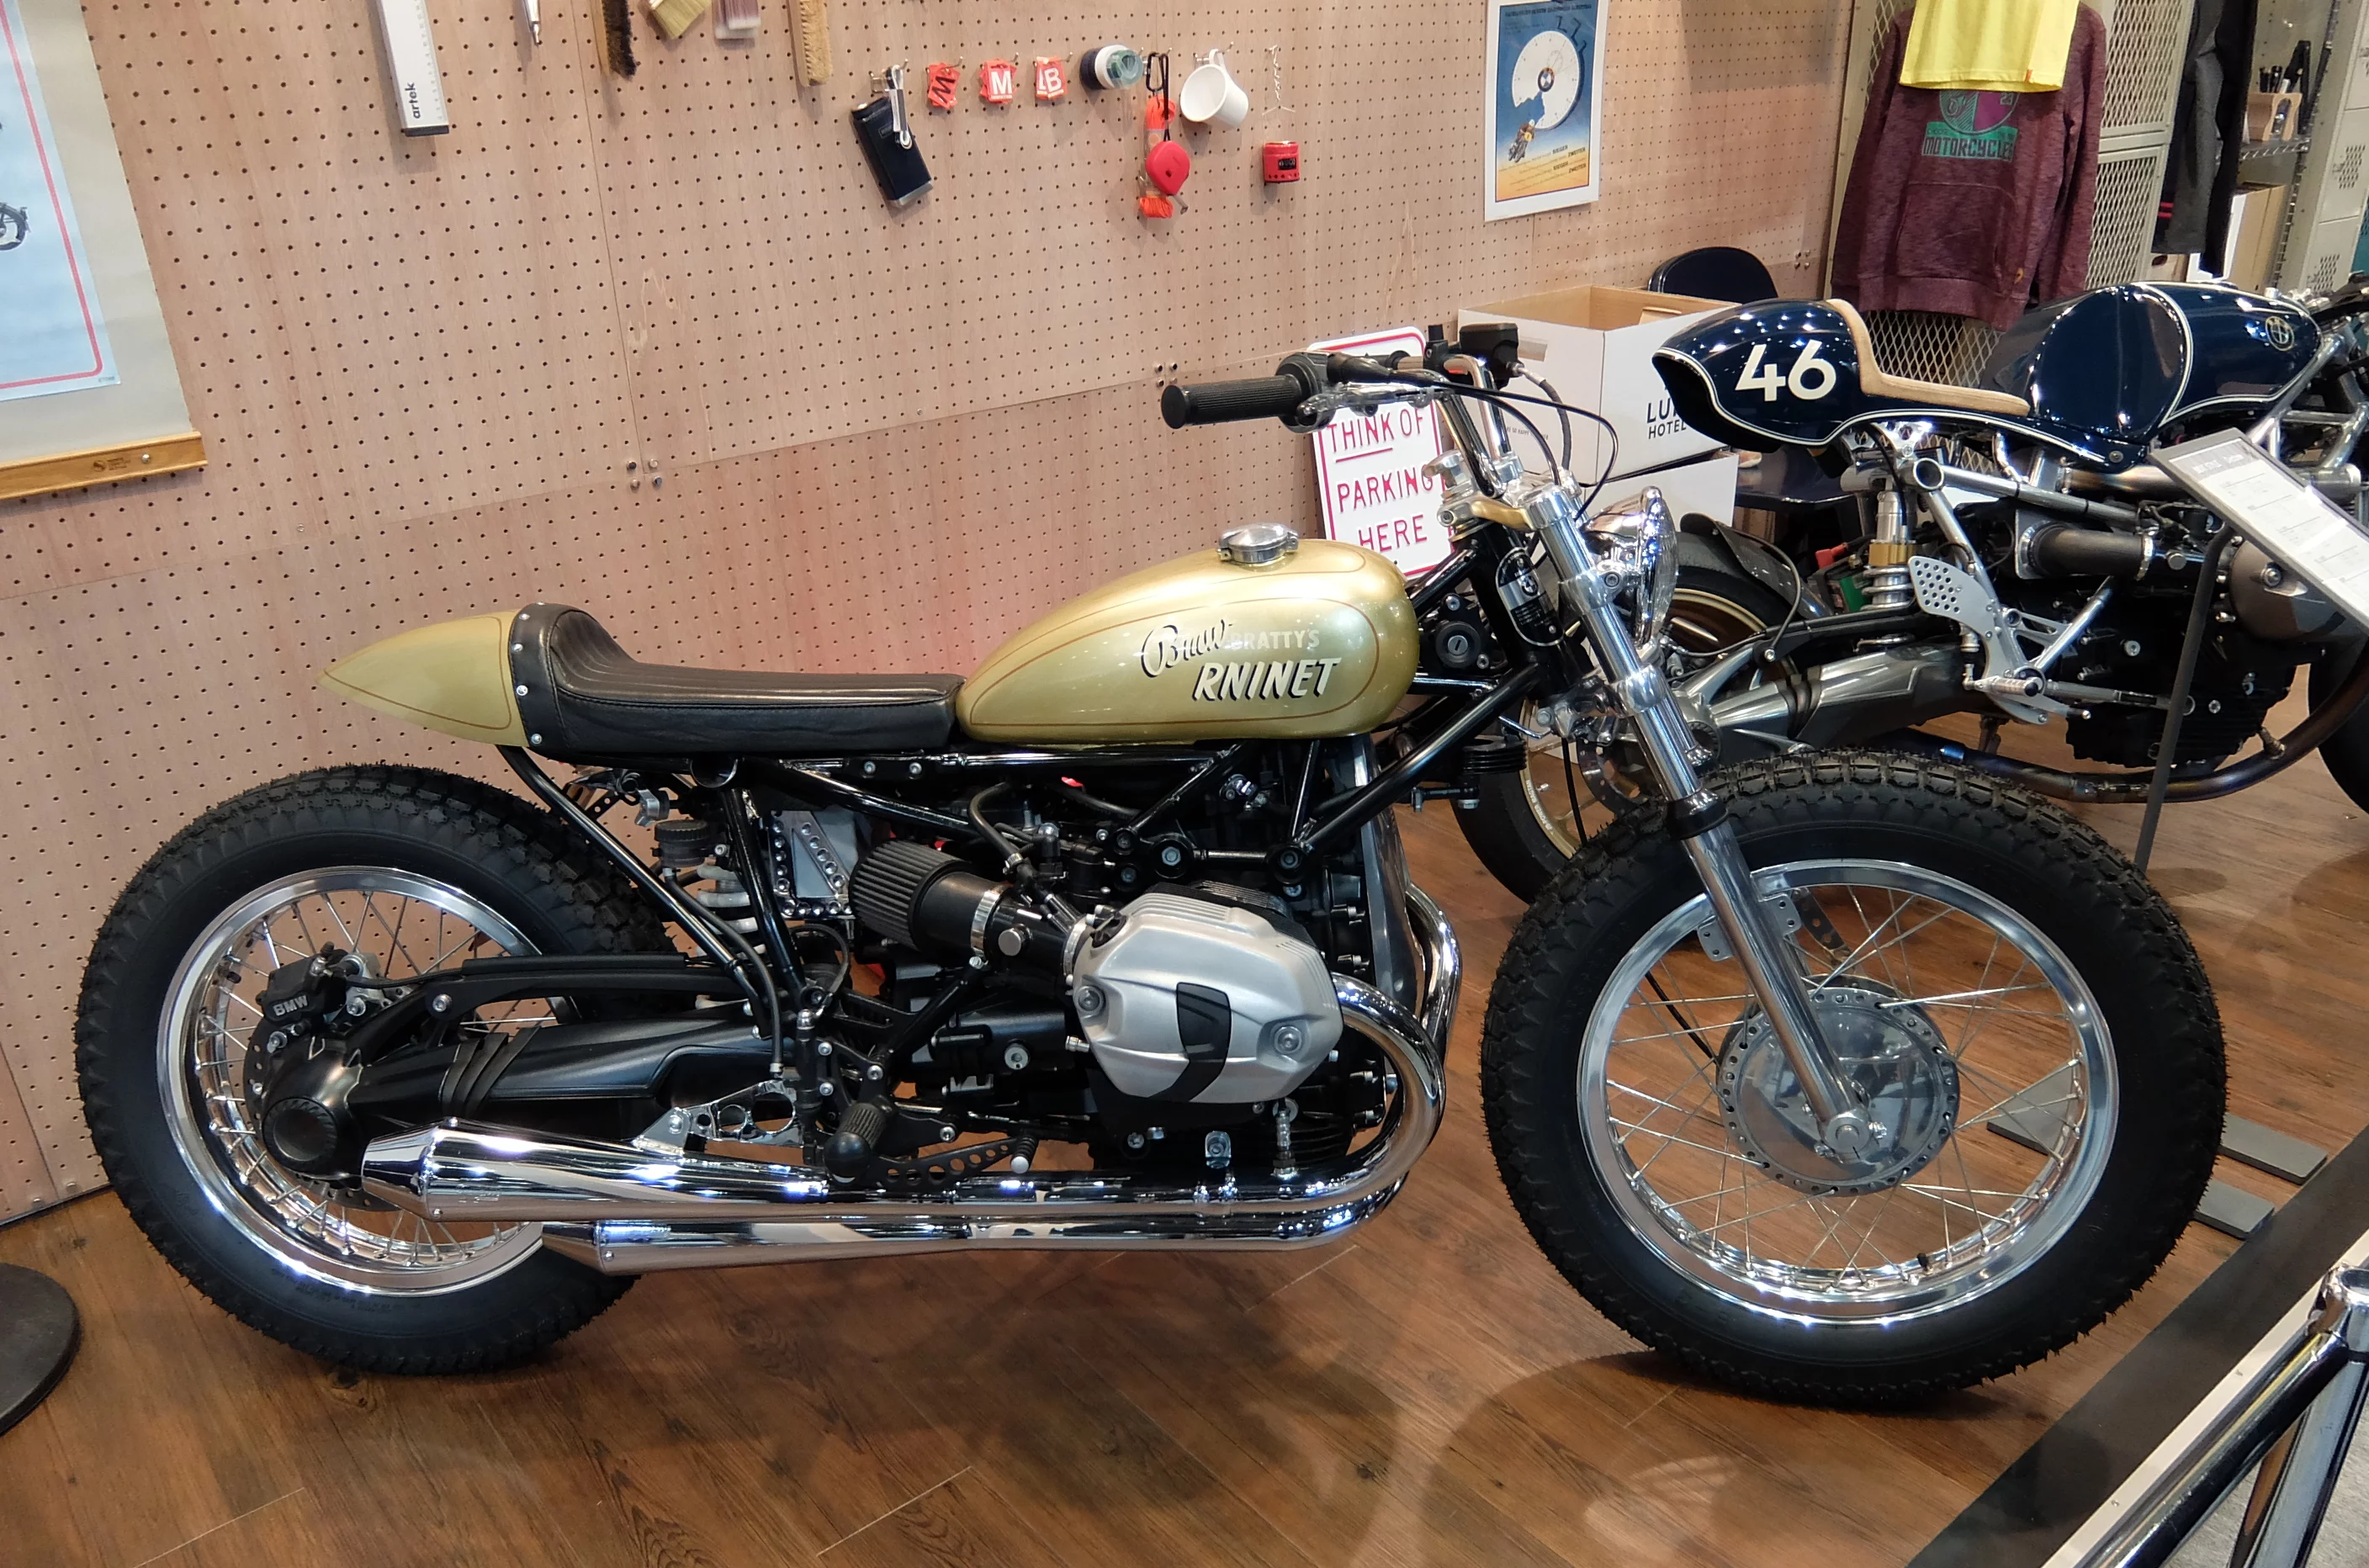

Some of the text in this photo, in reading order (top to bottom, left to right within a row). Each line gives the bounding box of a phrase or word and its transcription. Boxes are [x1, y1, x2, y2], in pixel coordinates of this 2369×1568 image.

[990, 70, 1012, 94] M
[1044, 67, 1062, 91] B
[405, 82, 421, 119] artek
[1735, 339, 1836, 401] 46
[1646, 397, 1677, 423] LU
[1326, 407, 1423, 453] THINK OF
[1337, 464, 1434, 512] PARKING
[1358, 514, 1428, 552] HERE
[1231, 629, 1321, 650] BRATTY'S
[1191, 657, 1343, 702] RNINET
[273, 995, 308, 1016] BMW
